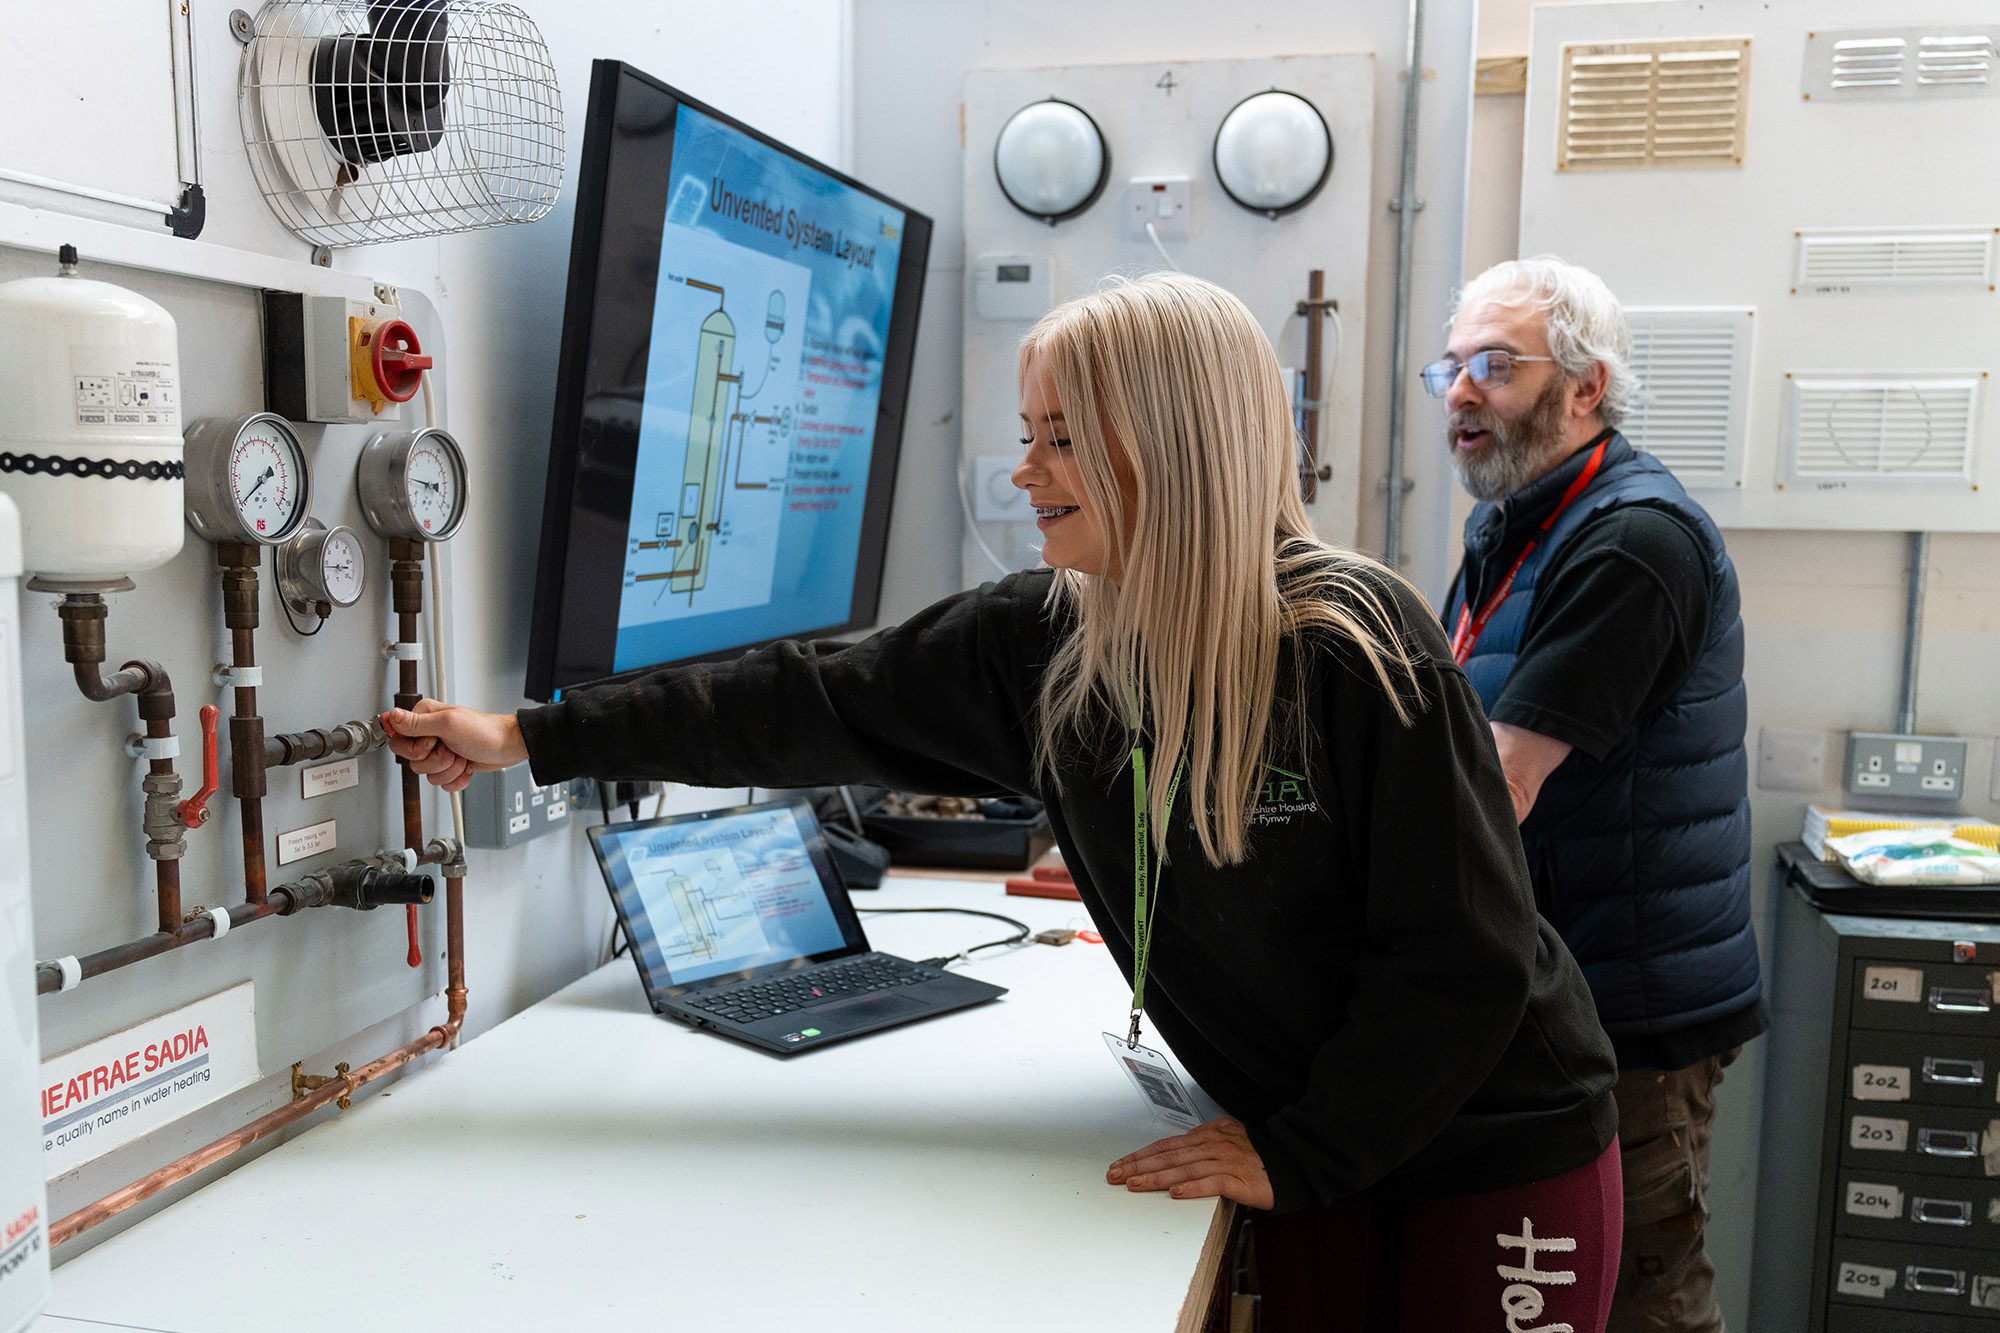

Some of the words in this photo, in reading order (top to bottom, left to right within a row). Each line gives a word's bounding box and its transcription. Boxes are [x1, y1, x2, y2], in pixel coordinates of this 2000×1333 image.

[711, 176, 784, 235] Unvented
[785, 208, 834, 256] System
[836, 229, 876, 270] Layout
[256, 518, 266, 530] RS
[1279, 801, 1318, 813] Housing
[1259, 813, 1292, 826] Fynwy
[647, 836, 700, 854] Unvented
[703, 831, 740, 846] System
[742, 824, 776, 838] Layout
[1138, 825, 1147, 871] Respectful,
[1138, 873, 1146, 898] Ready,
[1137, 919, 1145, 948] GWENT
[1871, 977, 1898, 991] 201
[144, 1025, 209, 1072] SADIA
[1863, 1072, 1900, 1089] 202
[57, 1119, 95, 1147] quality
[97, 1105, 129, 1128] name
[131, 1098, 142, 1112] in
[143, 1085, 171, 1106] water
[173, 1068, 211, 1093] heating
[1859, 1124, 1894, 1142] 203
[1854, 1191, 1891, 1209] 204
[1845, 1270, 1881, 1287] 205
